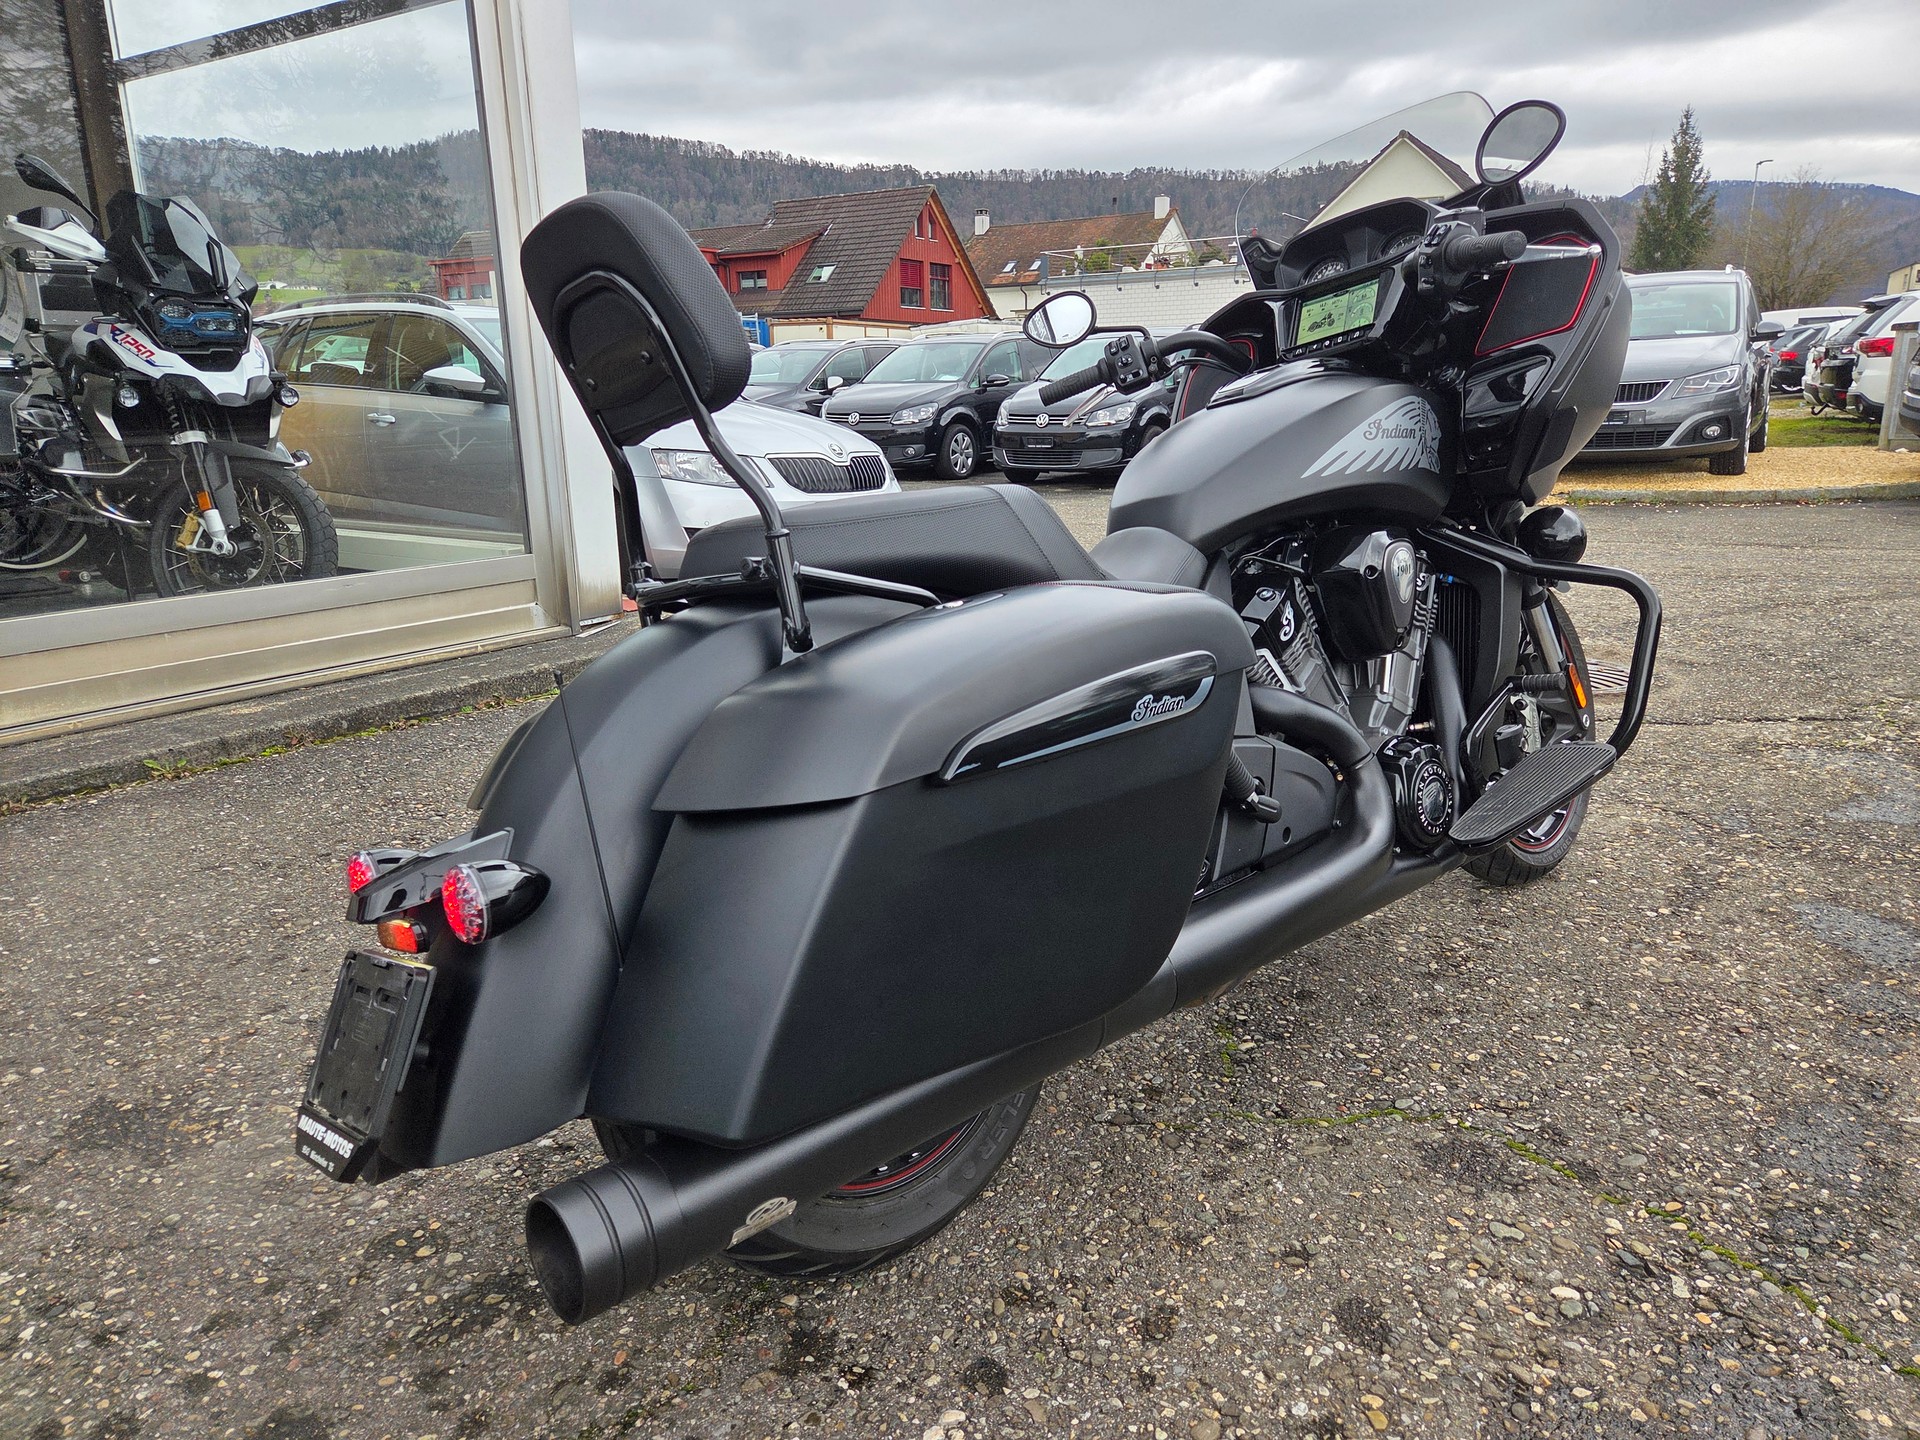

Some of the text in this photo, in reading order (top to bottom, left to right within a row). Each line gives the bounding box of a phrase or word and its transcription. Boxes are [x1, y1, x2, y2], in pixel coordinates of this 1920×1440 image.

[1363, 418, 1416, 441] Indian
[1131, 694, 1186, 722] Indian
[1417, 781, 1429, 827] INDIAN
[978, 1092, 1026, 1160] ELER
